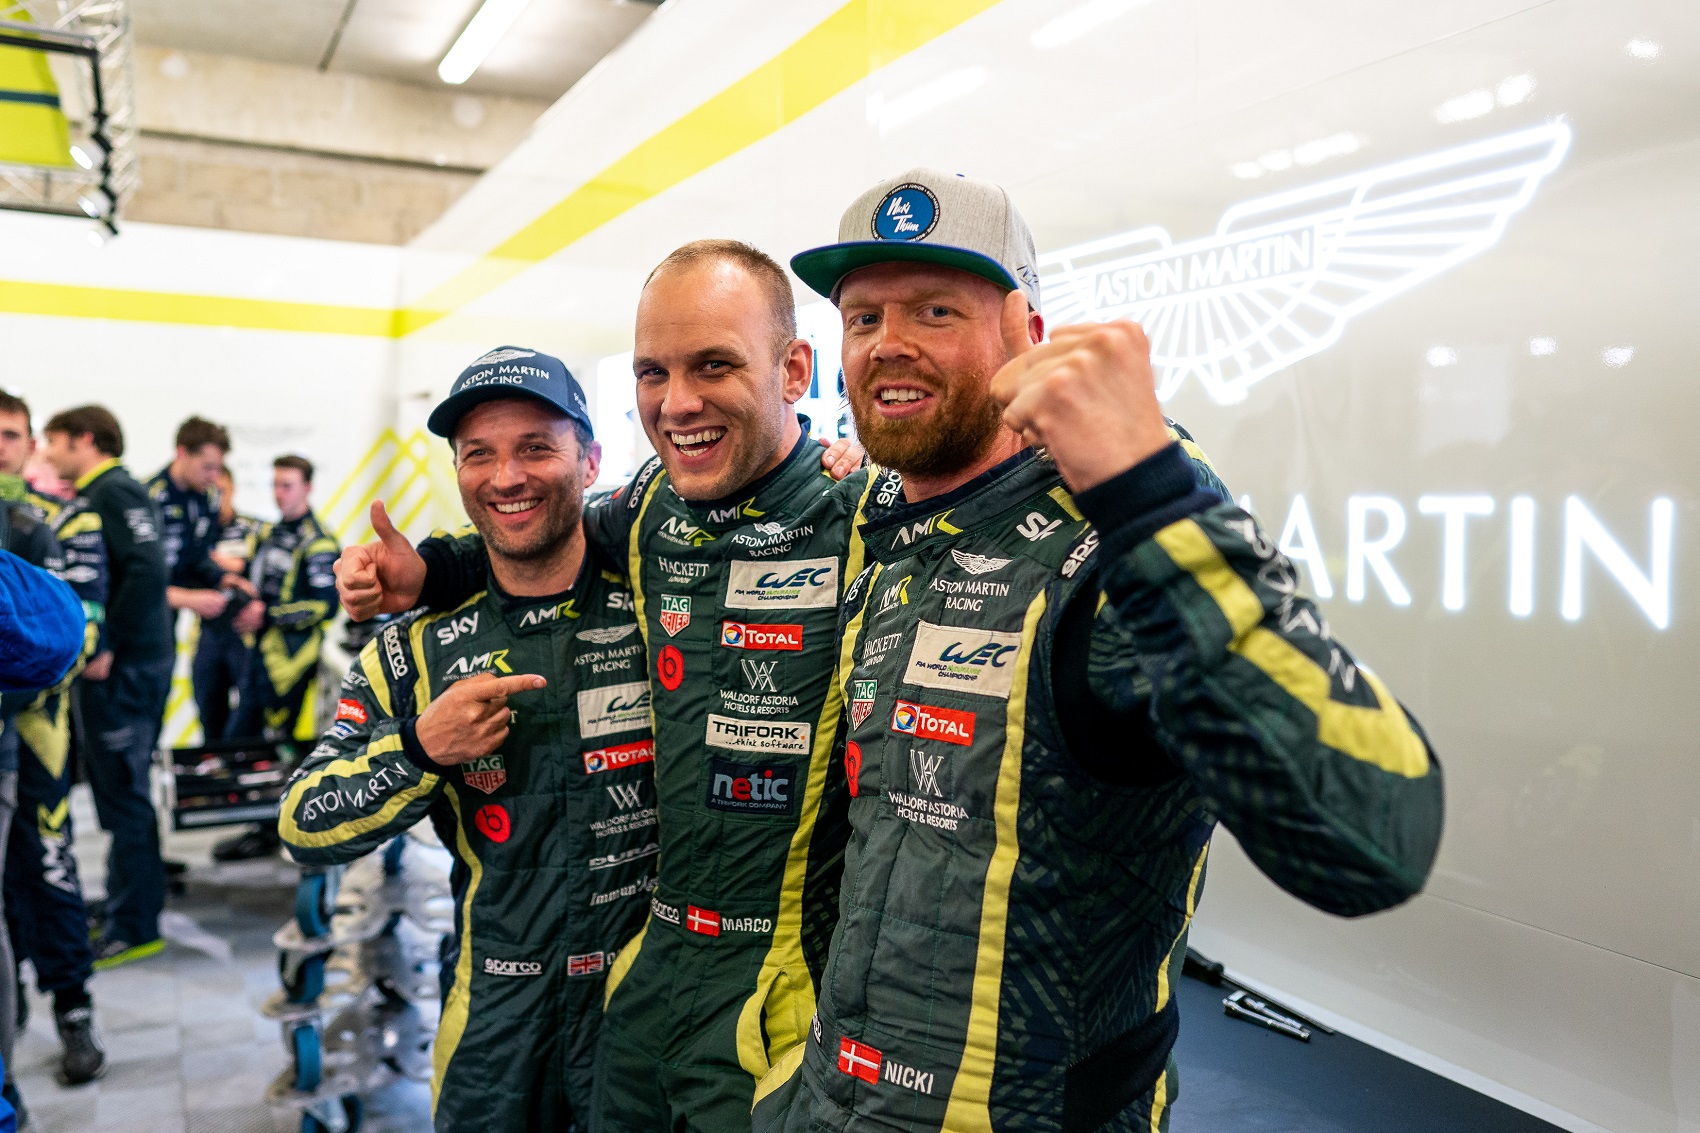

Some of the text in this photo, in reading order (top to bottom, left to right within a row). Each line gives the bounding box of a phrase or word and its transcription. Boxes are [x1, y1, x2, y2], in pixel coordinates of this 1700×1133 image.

[1096, 257, 1182, 310] ASTON
[1189, 230, 1310, 290] MARTIN
[460, 365, 550, 391] ASTON MARTIN
[876, 469, 903, 507] spa
[707, 497, 766, 523] AMR
[731, 525, 814, 548] ASTON MARTIN
[891, 508, 963, 550] AMR
[749, 543, 792, 558] RACING
[658, 556, 709, 577] HACKETT
[1239, 493, 1675, 631] ARTIN
[929, 577, 1010, 597] ASTON MARTIN
[663, 597, 688, 611] TAG
[945, 598, 983, 612] RACING
[519, 599, 581, 629] AMR
[660, 612, 689, 633] HEUER
[745, 630, 799, 645] TOTAL
[445, 649, 513, 675] AMR
[574, 651, 605, 666] ASTON
[592, 659, 631, 674] RACING
[938, 671, 978, 681] CHAMPIONSHIP
[720, 690, 799, 706] WALDORF ASTORIA
[855, 682, 874, 699] TAG
[606, 690, 651, 713] WE
[724, 701, 789, 715] HOTELS & RESORTS
[919, 712, 970, 738] TOTAL
[760, 739, 804, 750] software
[467, 757, 501, 771] TAG
[713, 769, 788, 801] netic
[929, 801, 969, 819] ASTORIA
[919, 813, 926, 824] &
[926, 814, 958, 831] RESORTS
[722, 918, 772, 933] MARCO
[484, 958, 542, 975] sparco
[885, 1060, 934, 1094] NICKI
